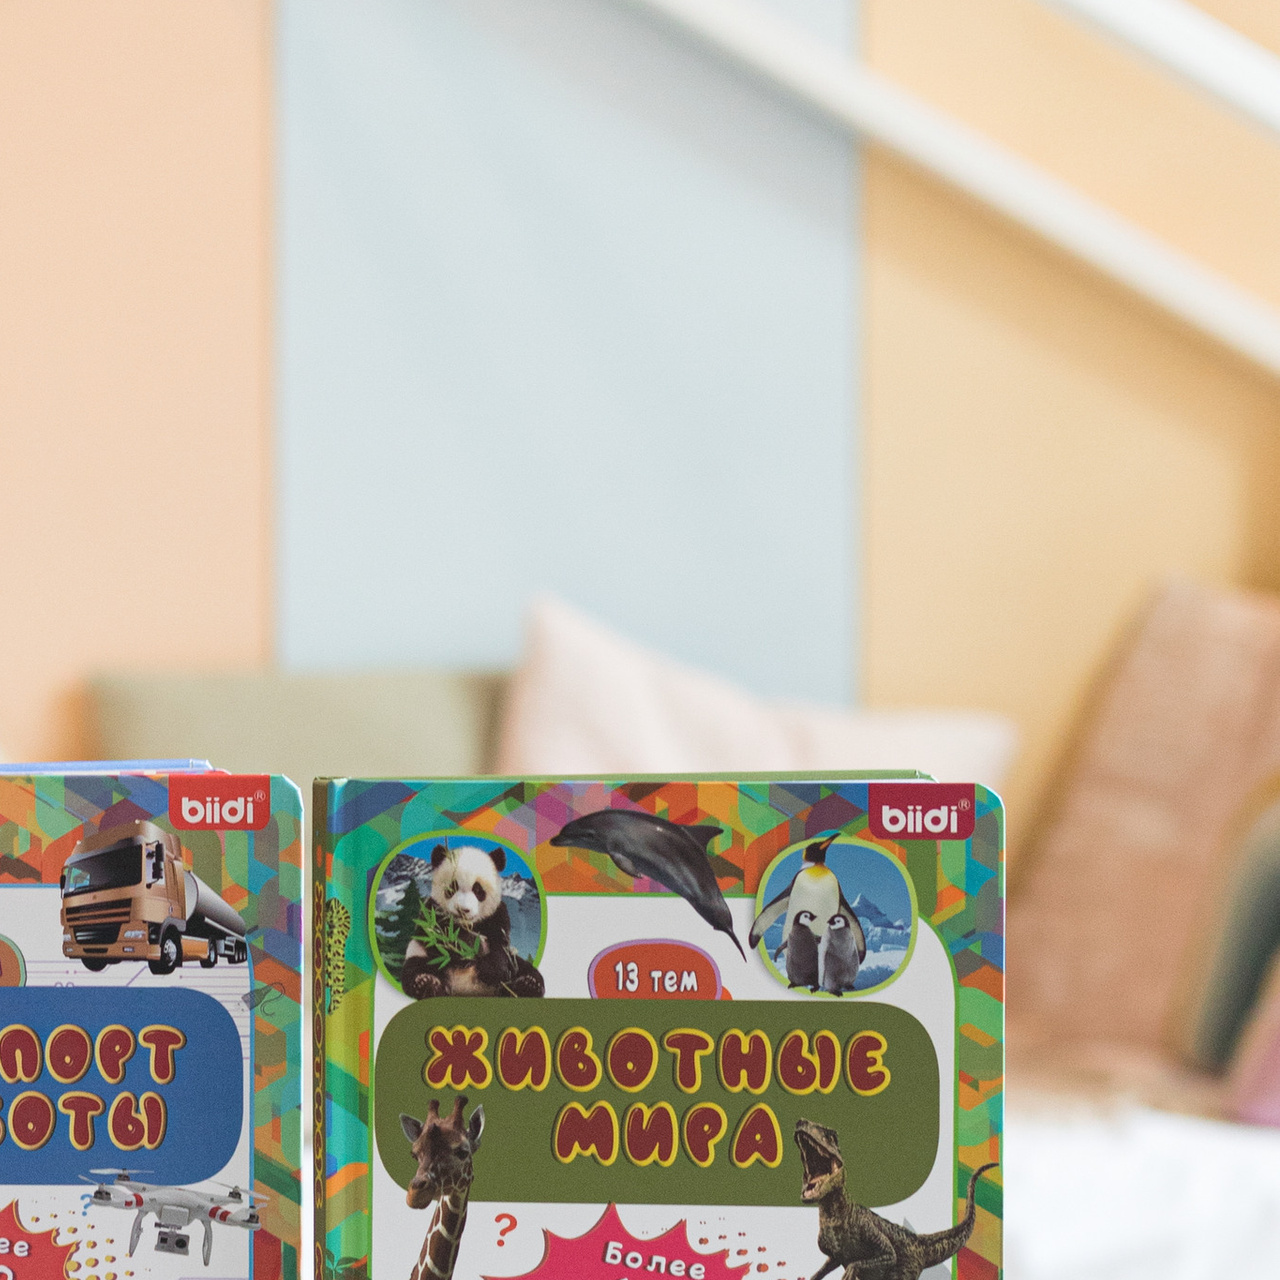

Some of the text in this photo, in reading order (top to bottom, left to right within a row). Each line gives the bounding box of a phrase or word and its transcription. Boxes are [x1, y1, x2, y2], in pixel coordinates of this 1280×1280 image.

[614, 960, 699, 993] 13 тем
[424, 1024, 892, 1097] ЖИВОТНЫЕ
[552, 1100, 784, 1169] МИРА
[603, 1240, 706, 1280] Более
